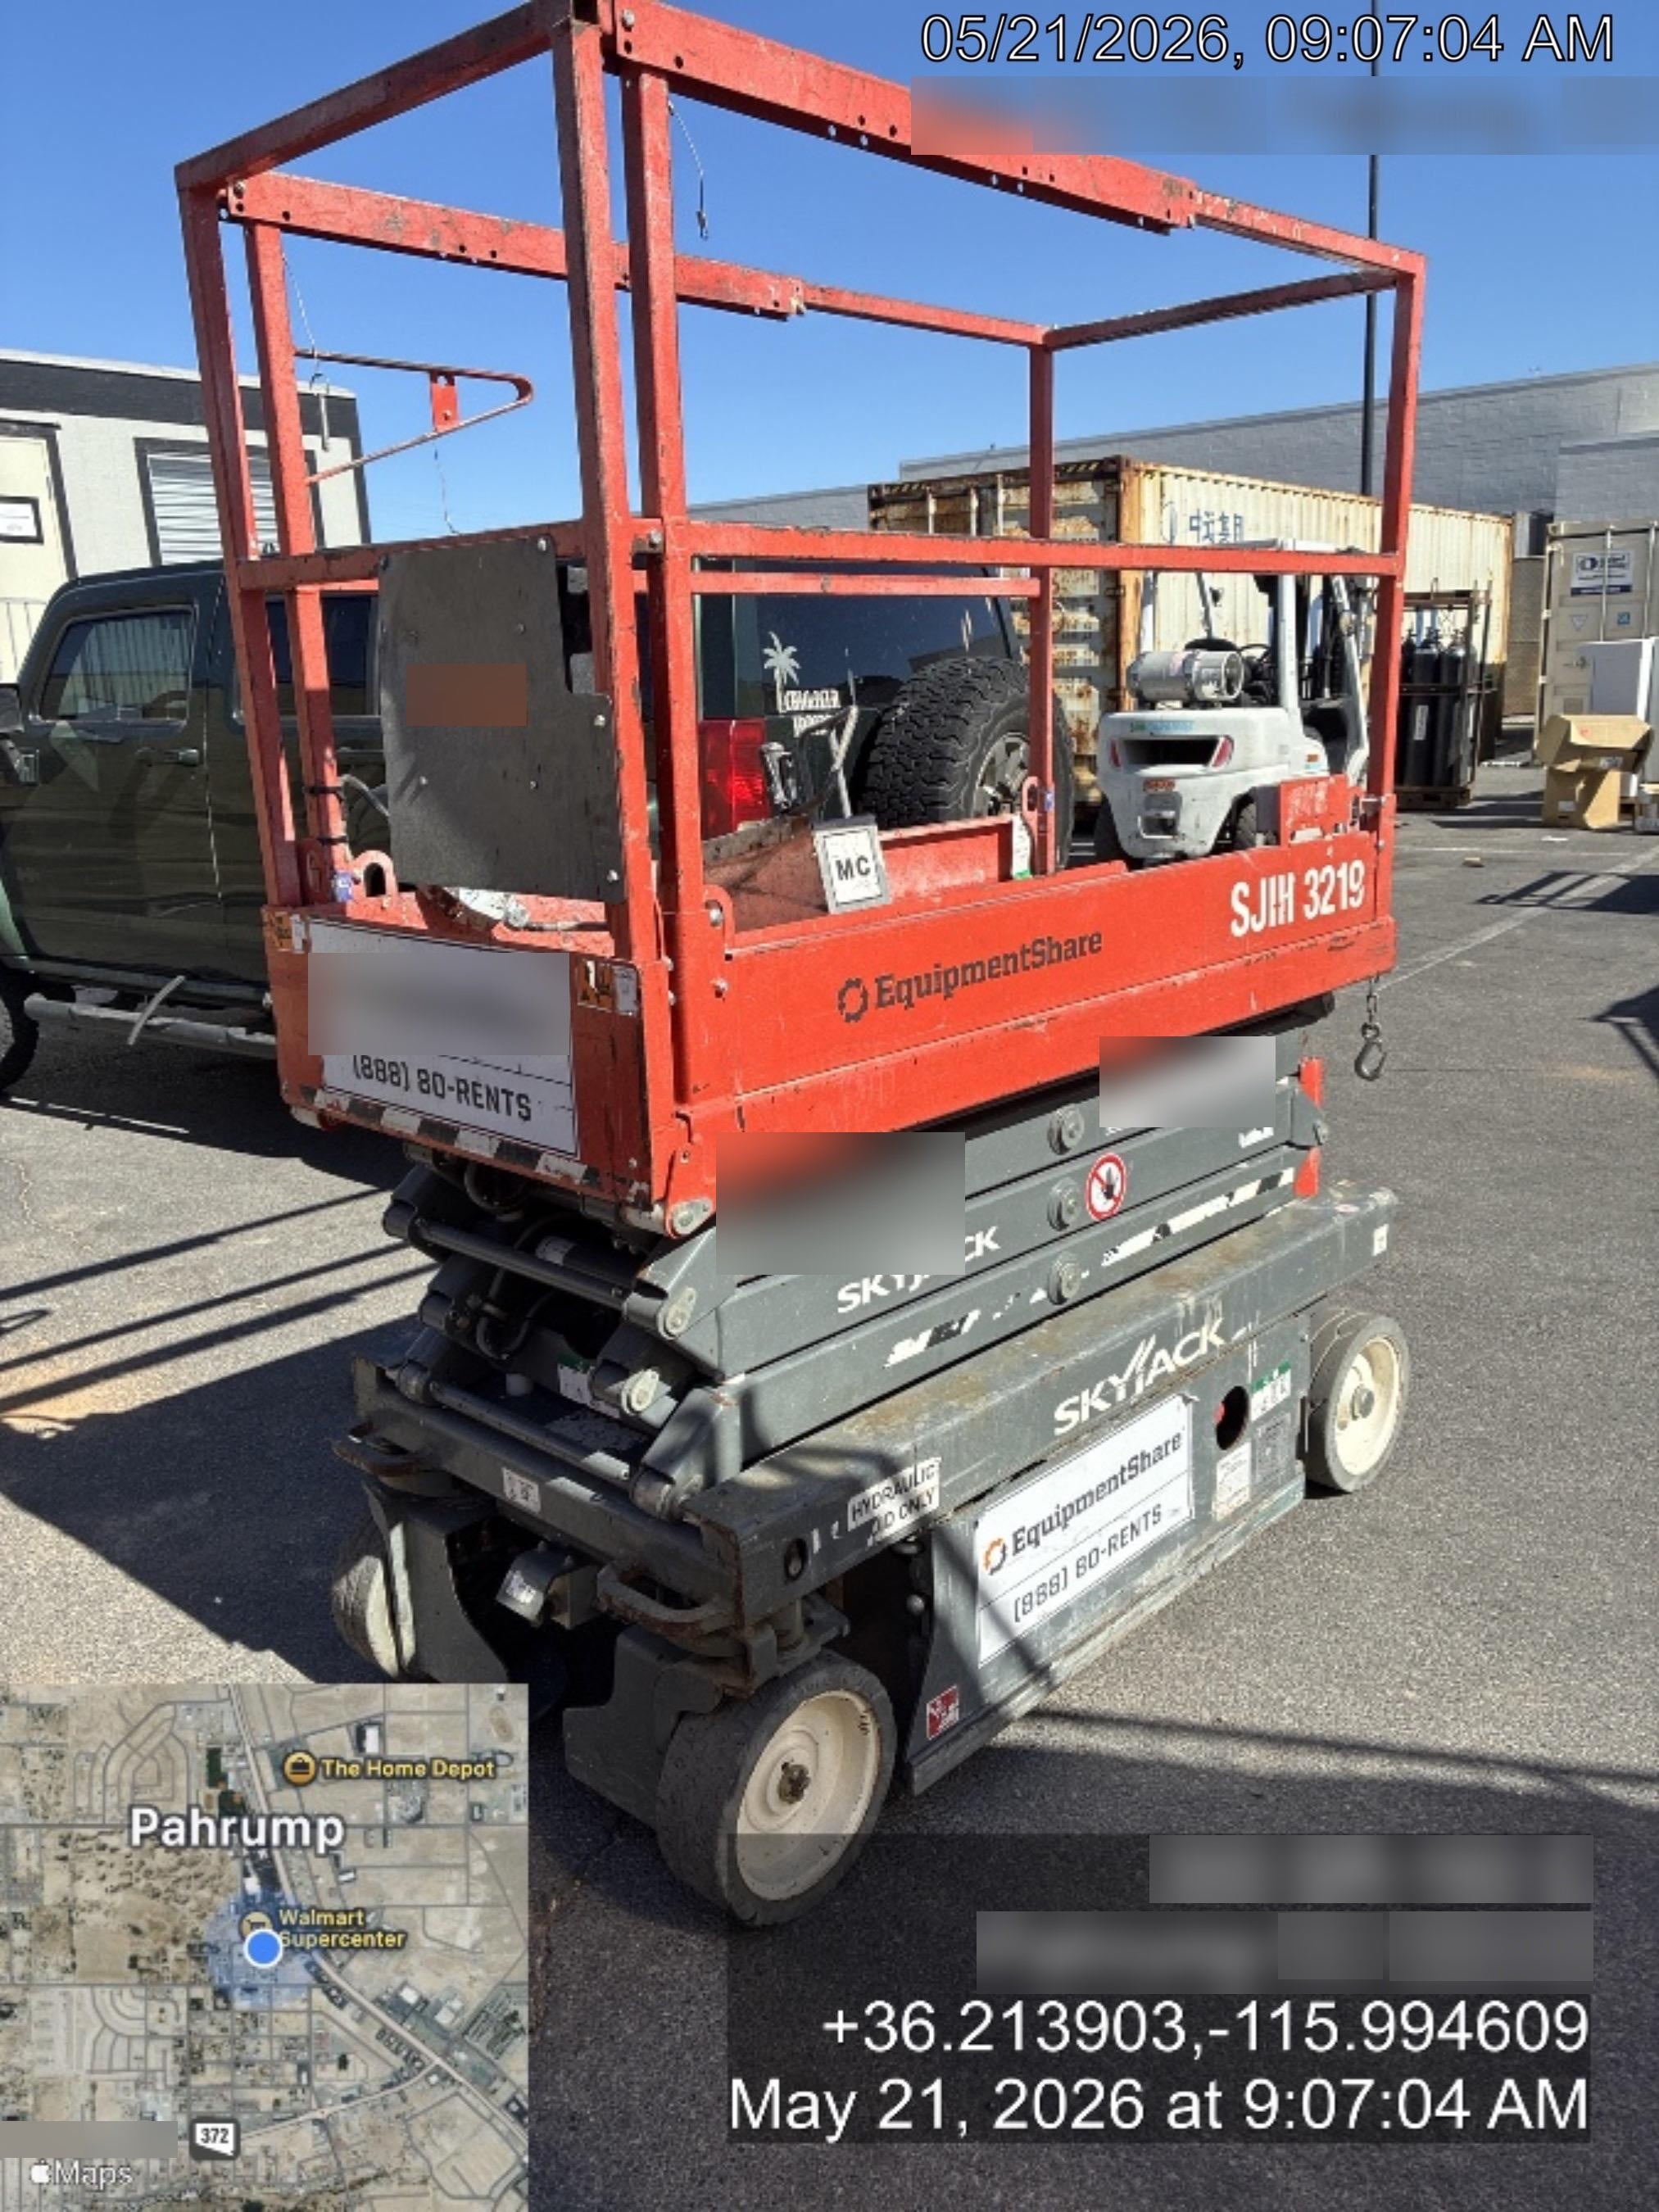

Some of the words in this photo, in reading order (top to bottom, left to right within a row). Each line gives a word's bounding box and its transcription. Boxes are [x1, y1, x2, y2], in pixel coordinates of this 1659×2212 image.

[836, 855, 870, 881] MC
[1303, 859, 1366, 921] 3219
[874, 931, 1103, 1011] EquipmentShare
[416, 1067, 533, 1122] 80-RENTS
[1054, 1317, 1226, 1436] SKYJACK
[1011, 1431, 1183, 1557] EquipmentShare
[1014, 1566, 1068, 1623] (888)
[1076, 1503, 1163, 1580] 80-RENTS
